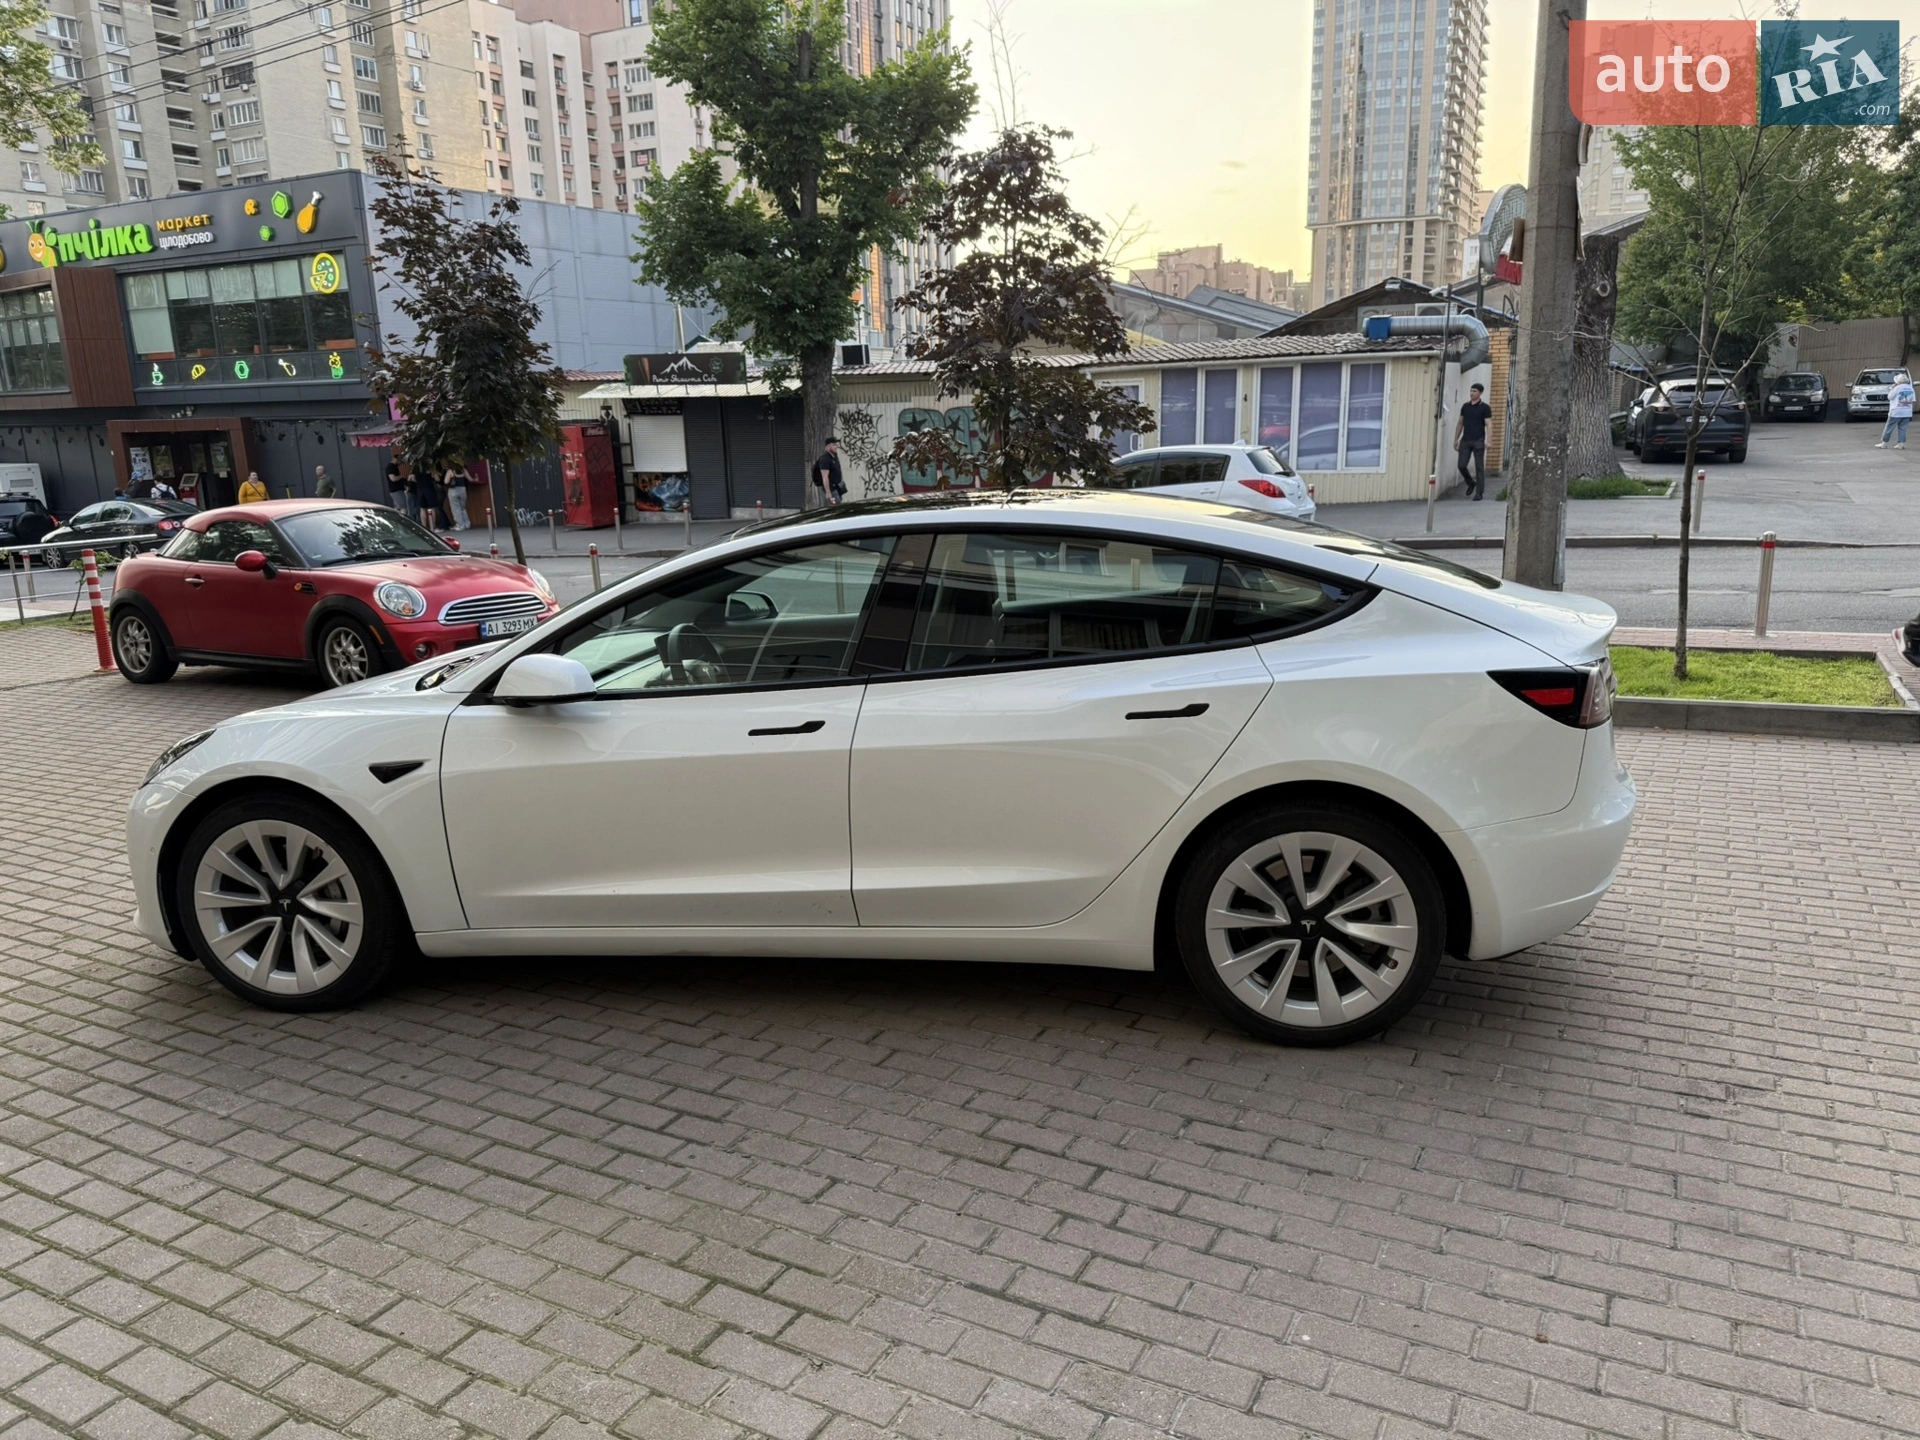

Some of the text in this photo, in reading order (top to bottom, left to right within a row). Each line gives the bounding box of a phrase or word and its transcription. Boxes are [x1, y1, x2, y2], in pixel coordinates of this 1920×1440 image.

[156, 214, 211, 232] маркет
[57, 219, 153, 263] пчілка
[864, 481, 895, 493] 2023
[488, 623, 499, 635] AI
[502, 620, 522, 632] 3293
